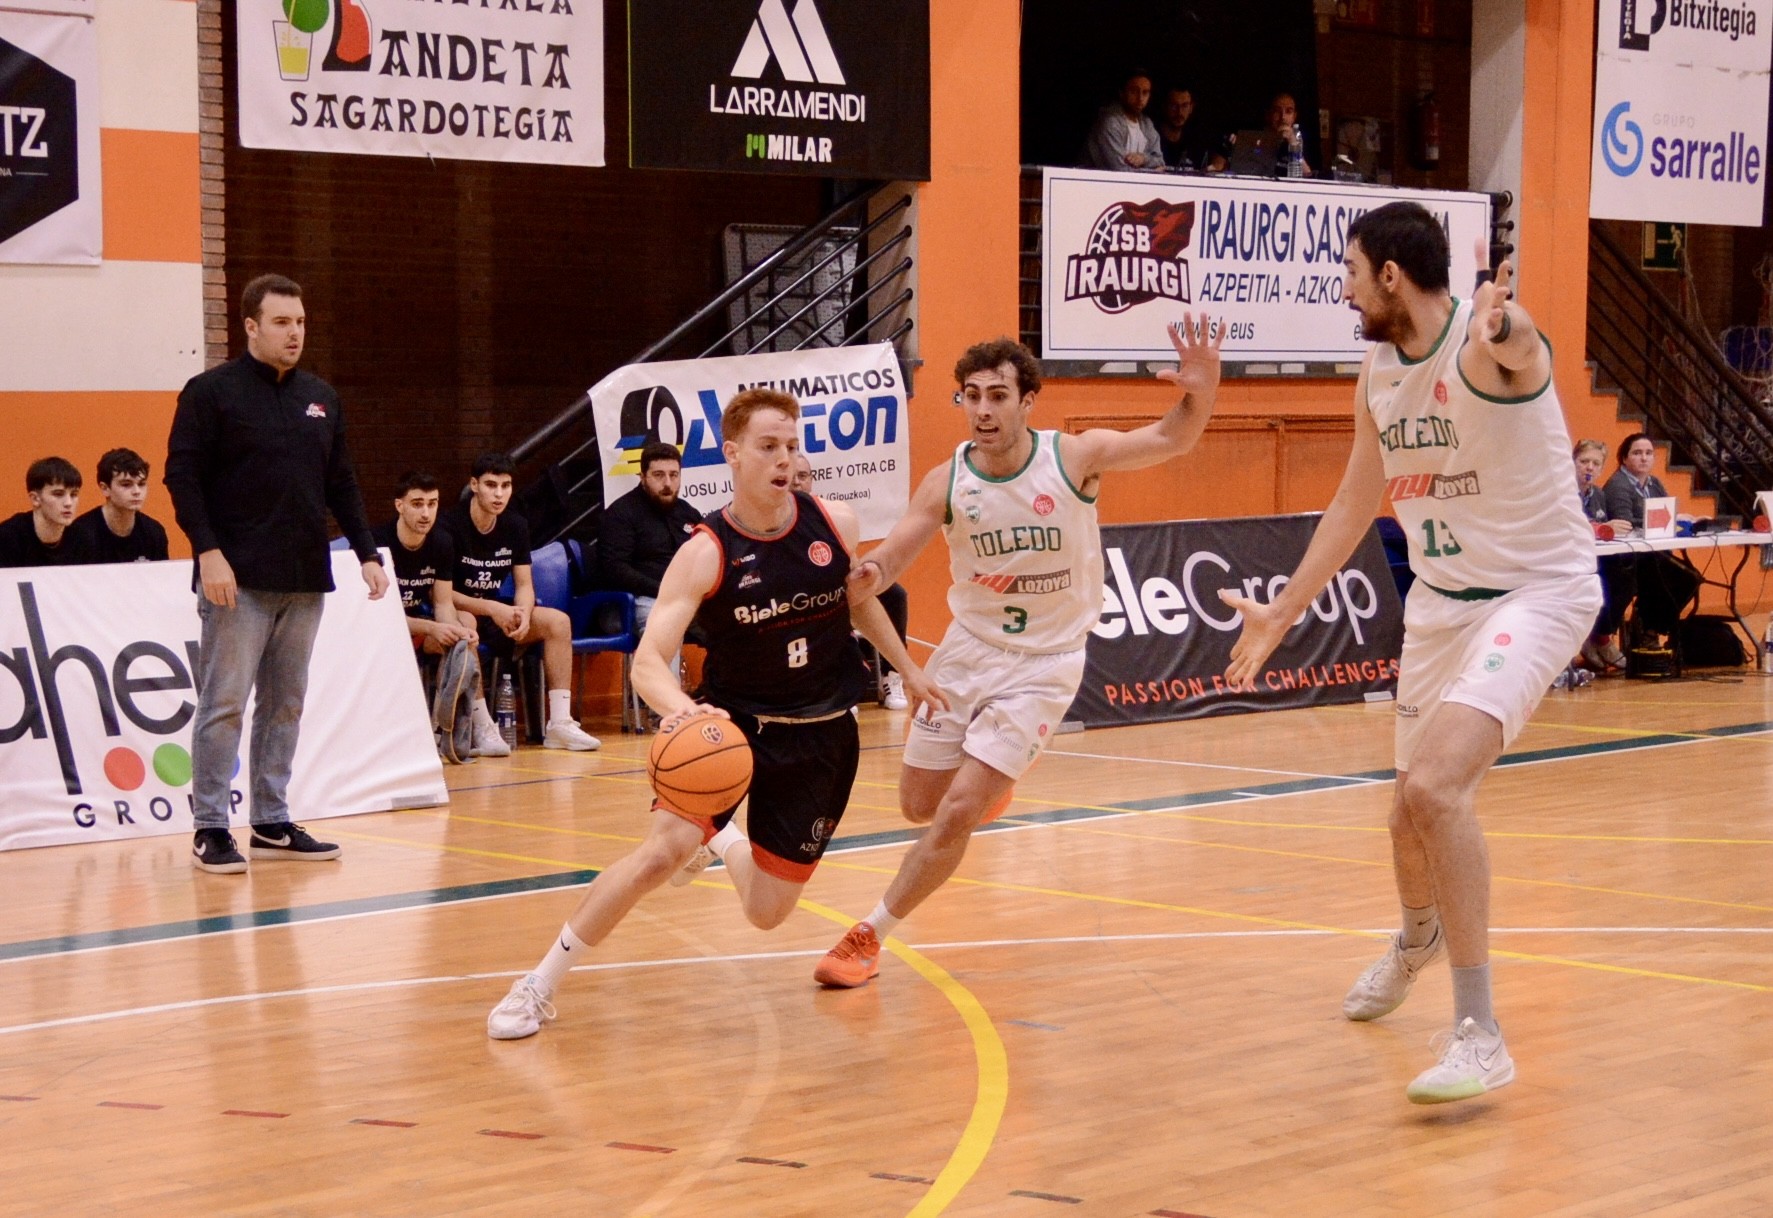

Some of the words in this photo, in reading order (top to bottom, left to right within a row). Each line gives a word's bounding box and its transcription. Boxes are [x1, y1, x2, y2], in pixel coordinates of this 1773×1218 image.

[1670, 0, 1756, 41] Bitxitegia
[710, 84, 866, 122] LARRAMENDI
[1652, 113, 1695, 129] GRUPO
[767, 134, 832, 163] MILAR
[1650, 131, 1761, 185] sarralle
[1109, 224, 1151, 252] ISB
[1199, 199, 1298, 263] IRAURGI
[1064, 252, 1191, 302] IRAURGI
[1199, 272, 1280, 302] AZPEITIA
[837, 466, 843, 476] Y
[846, 462, 876, 476] OTRA
[880, 459, 896, 471] CB
[682, 482, 717, 498] JOSU
[970, 526, 1062, 558] TOLEDO
[464, 579, 501, 589] BARAN
[478, 571, 492, 581] 22
[1002, 605, 1028, 635] 3
[787, 637, 808, 668] 8
[1104, 676, 1207, 706] PASSION
[1265, 658, 1400, 693] CHALLENGES
[73, 789, 243, 828] GROP
